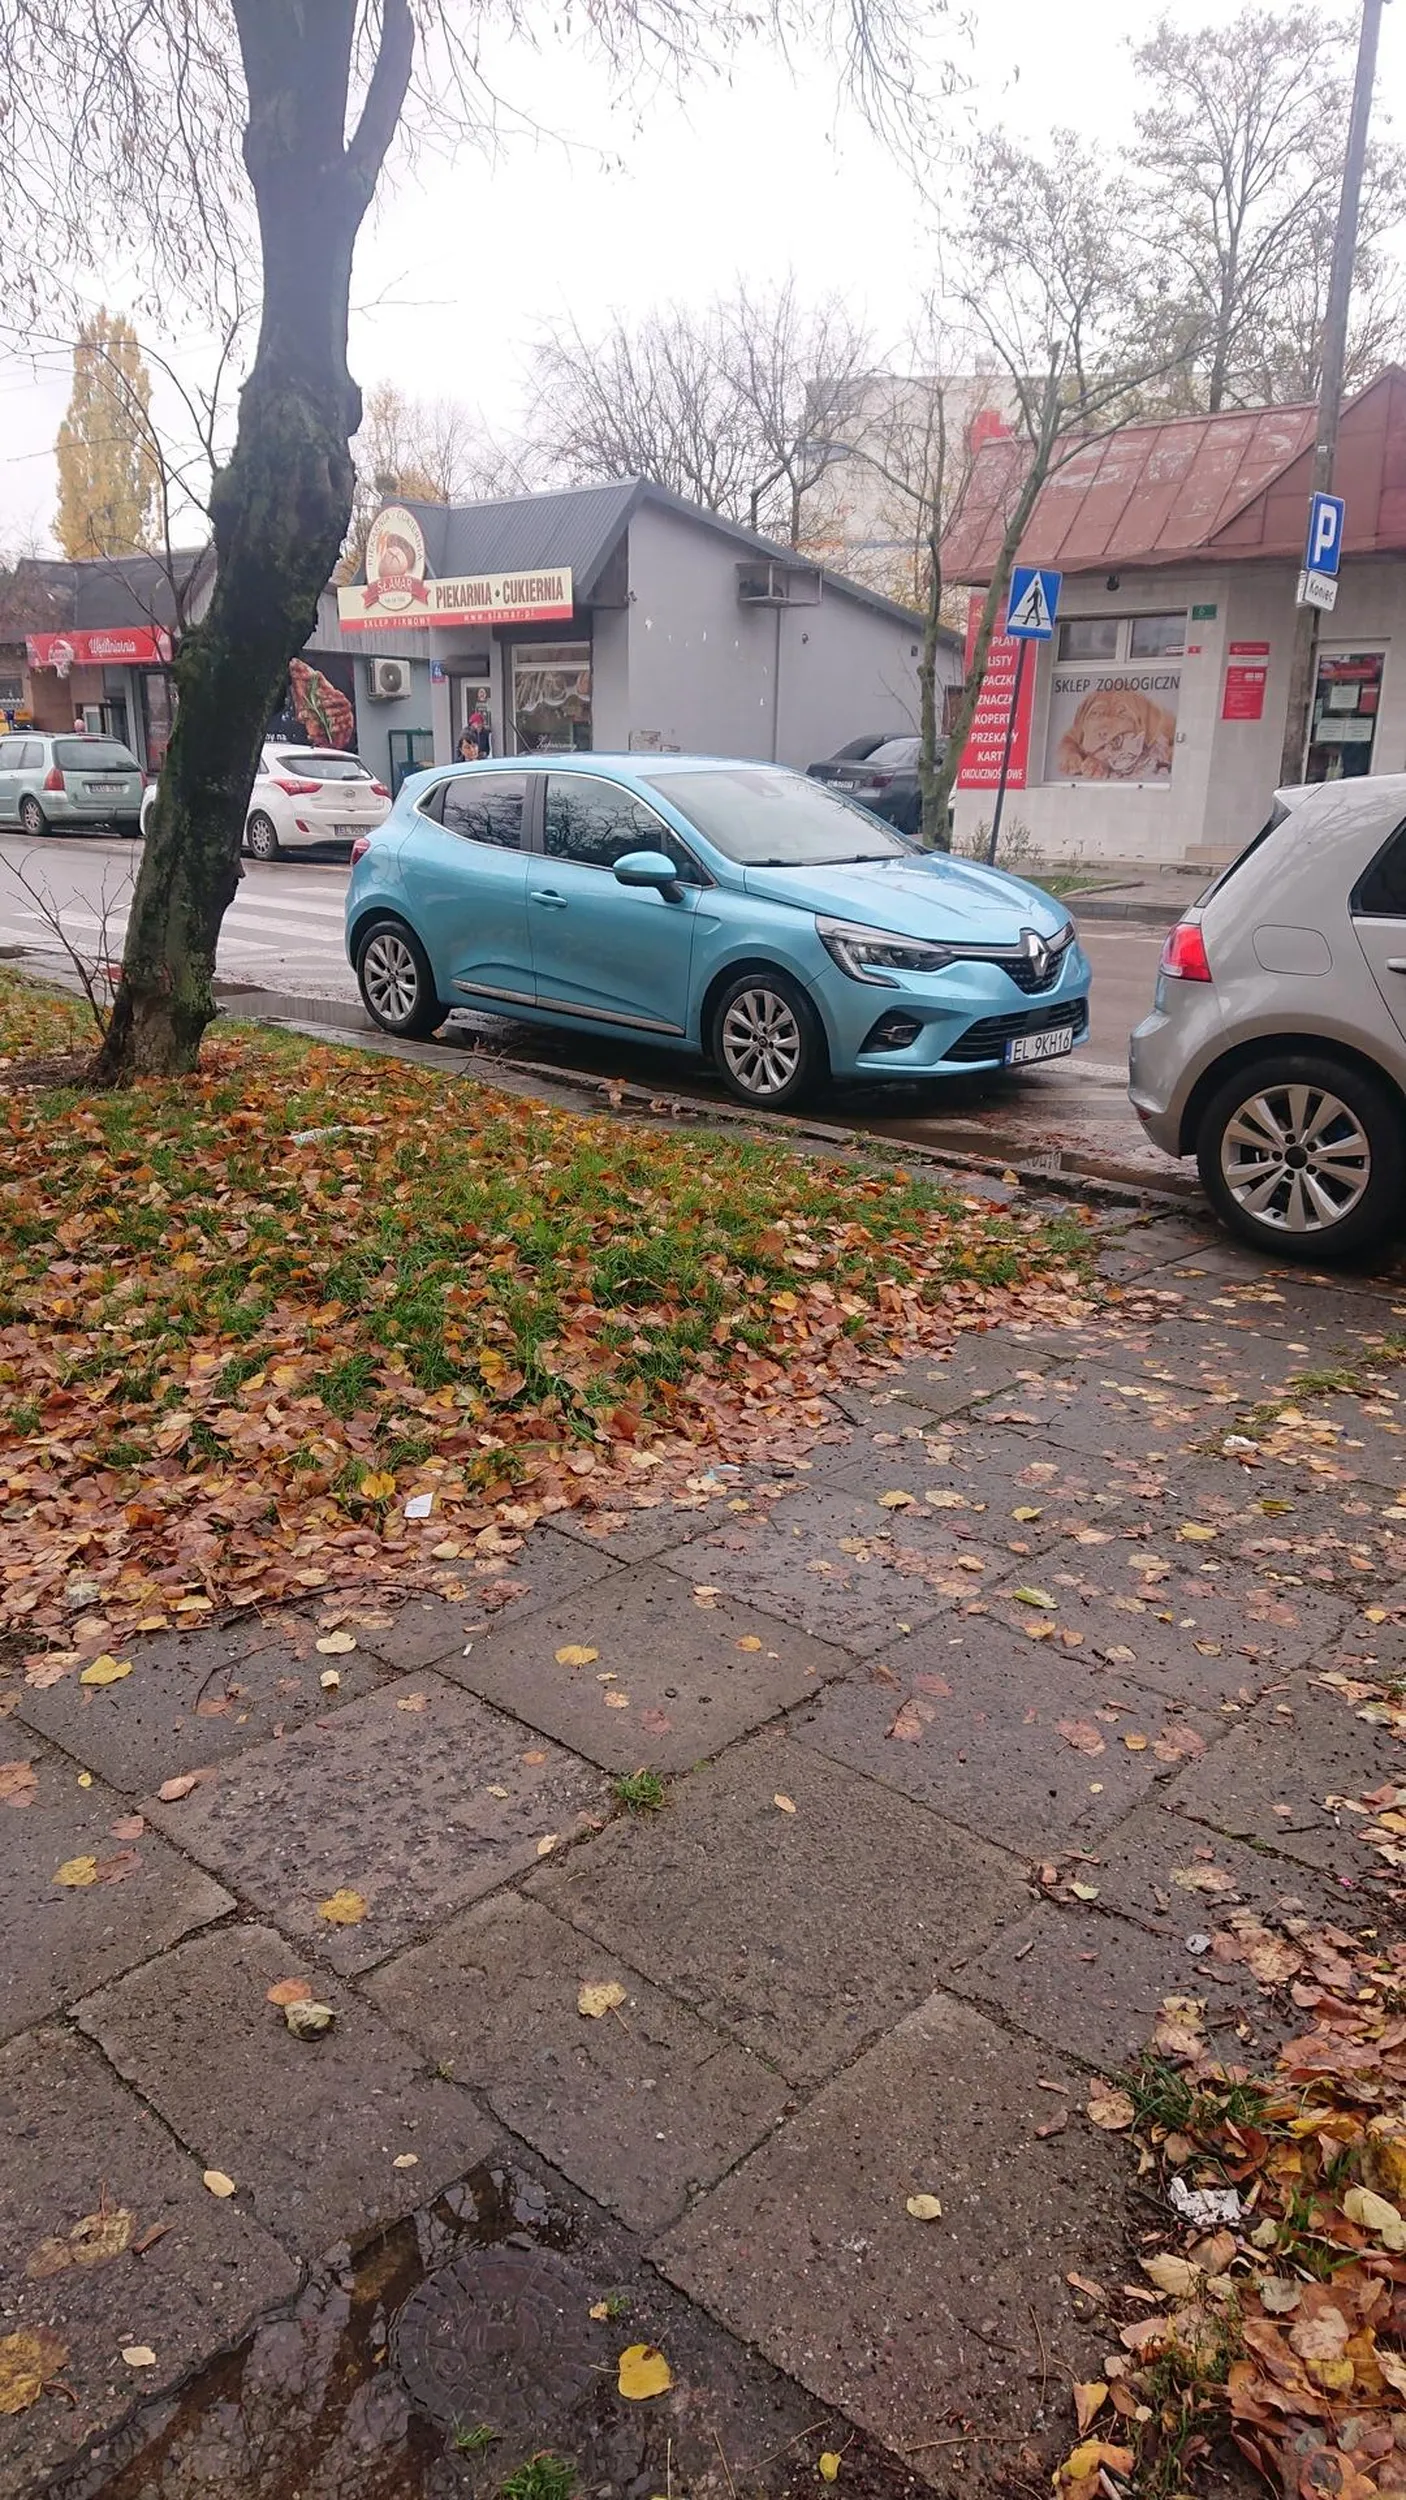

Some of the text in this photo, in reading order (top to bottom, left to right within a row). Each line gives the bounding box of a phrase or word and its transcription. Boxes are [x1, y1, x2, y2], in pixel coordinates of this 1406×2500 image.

[1313, 503, 1337, 564] P
[436, 576, 564, 609] PIEKARNIA CUKIERNIA
[1310, 579, 1334, 602] Koniec
[363, 619, 389, 629] SKLEP
[987, 655, 1012, 667] LISTY
[1055, 676, 1180, 693] SKLEP ZOOLOGICZN
[970, 731, 1019, 743] PRZEKAY
[977, 750, 1004, 762] KART
[961, 766, 1023, 780] OKOLICZNOŚOWE
[1014, 1030, 1070, 1061] EL 9KH16
